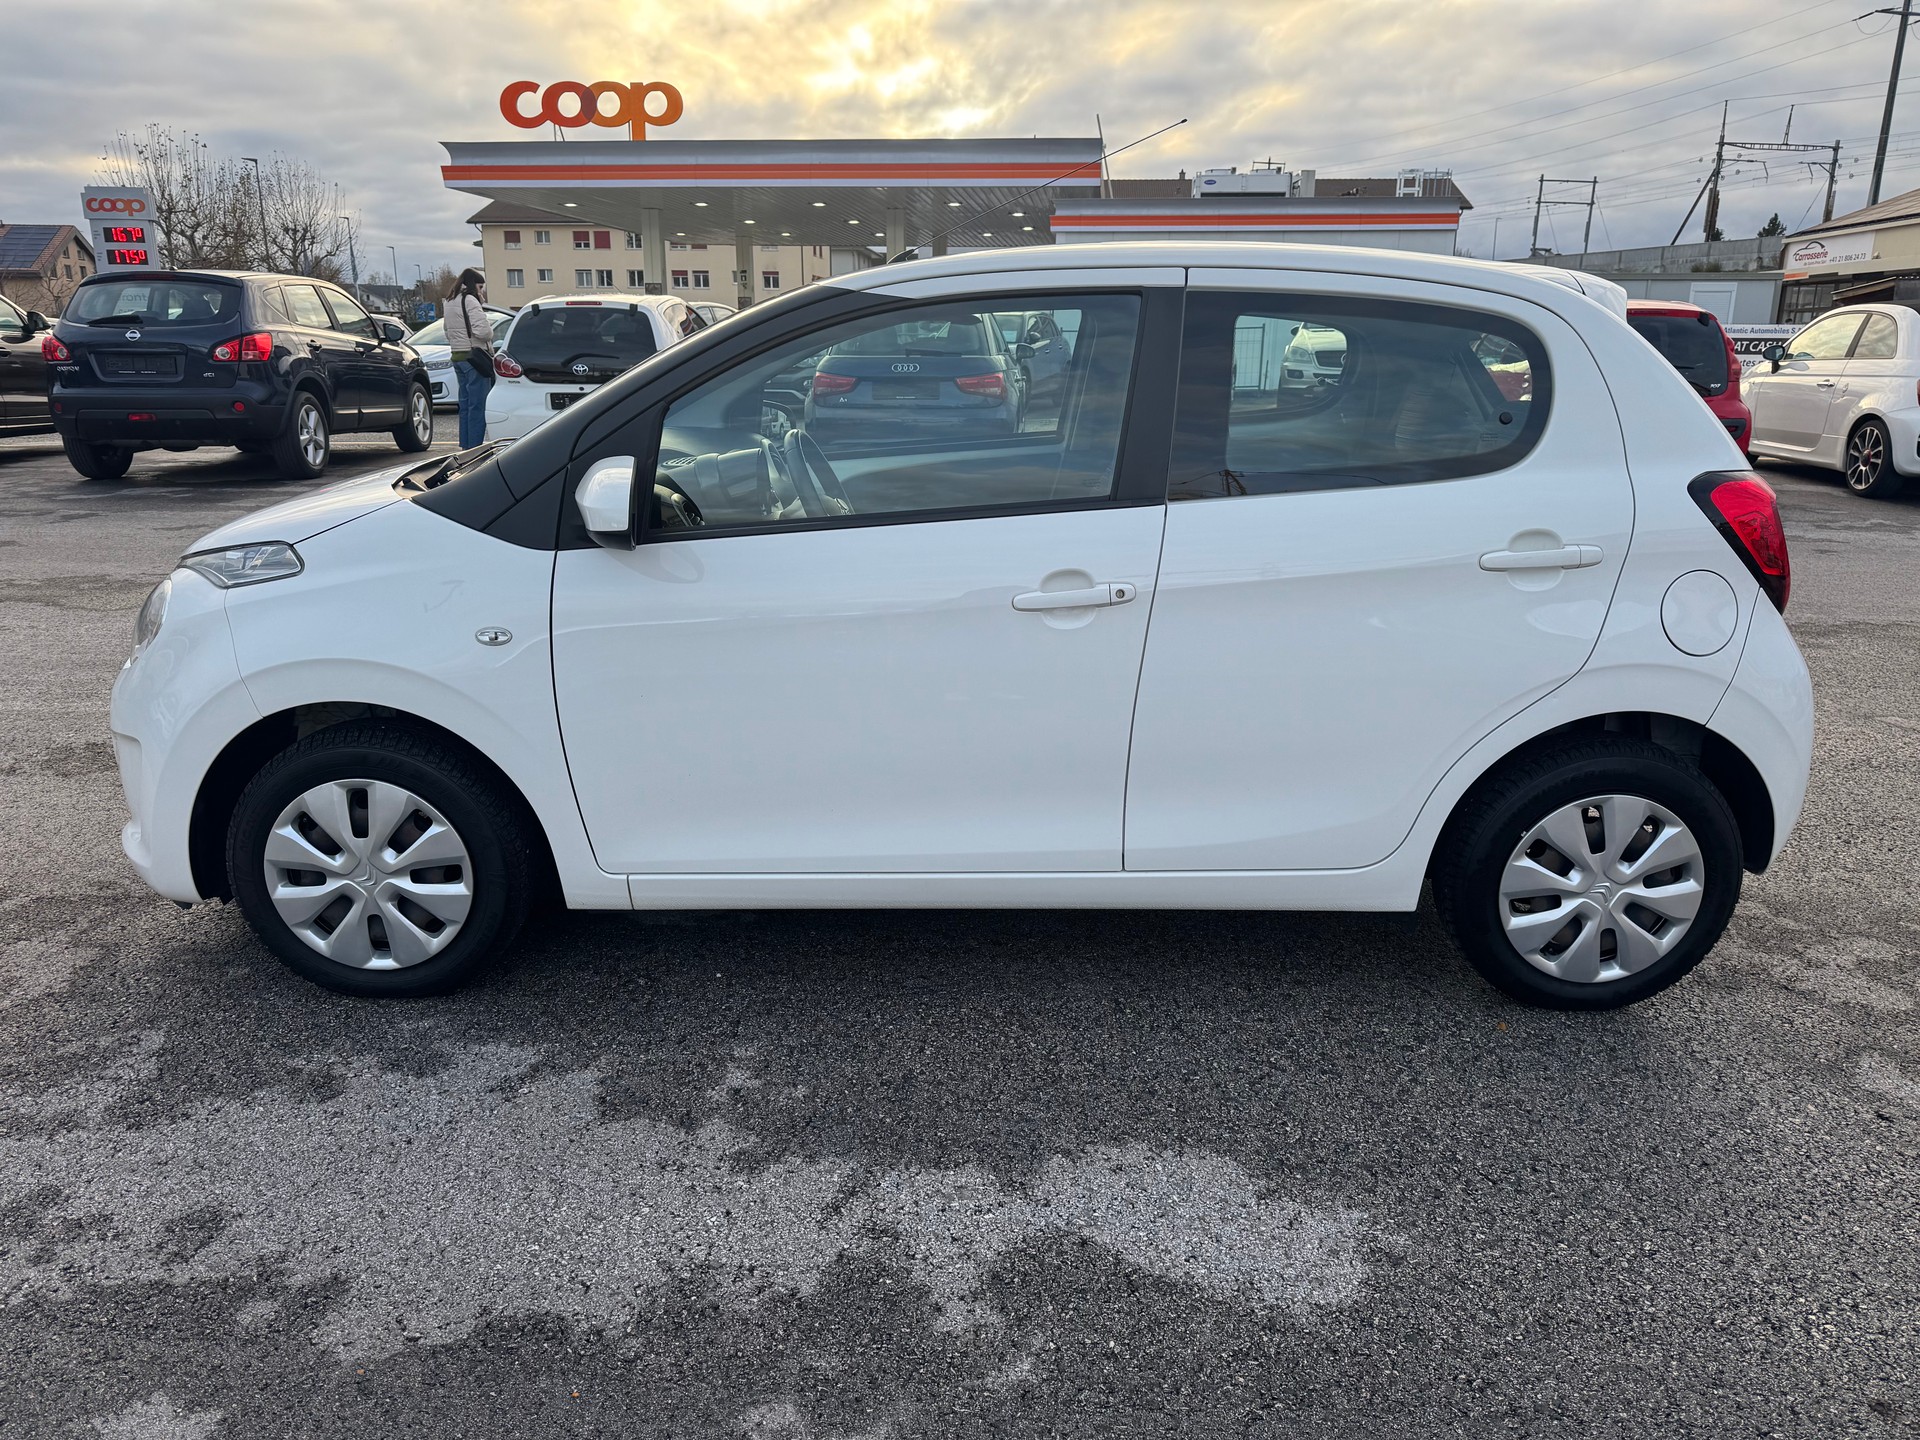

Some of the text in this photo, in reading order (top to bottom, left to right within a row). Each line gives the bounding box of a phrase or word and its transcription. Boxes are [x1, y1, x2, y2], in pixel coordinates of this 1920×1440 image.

[500, 80, 683, 141] coop
[86, 197, 146, 216] coop
[111, 227, 142, 242] 1670
[115, 249, 146, 264] 1750
[1795, 249, 1828, 261] Carrosserie
[1734, 341, 1749, 352] AT
